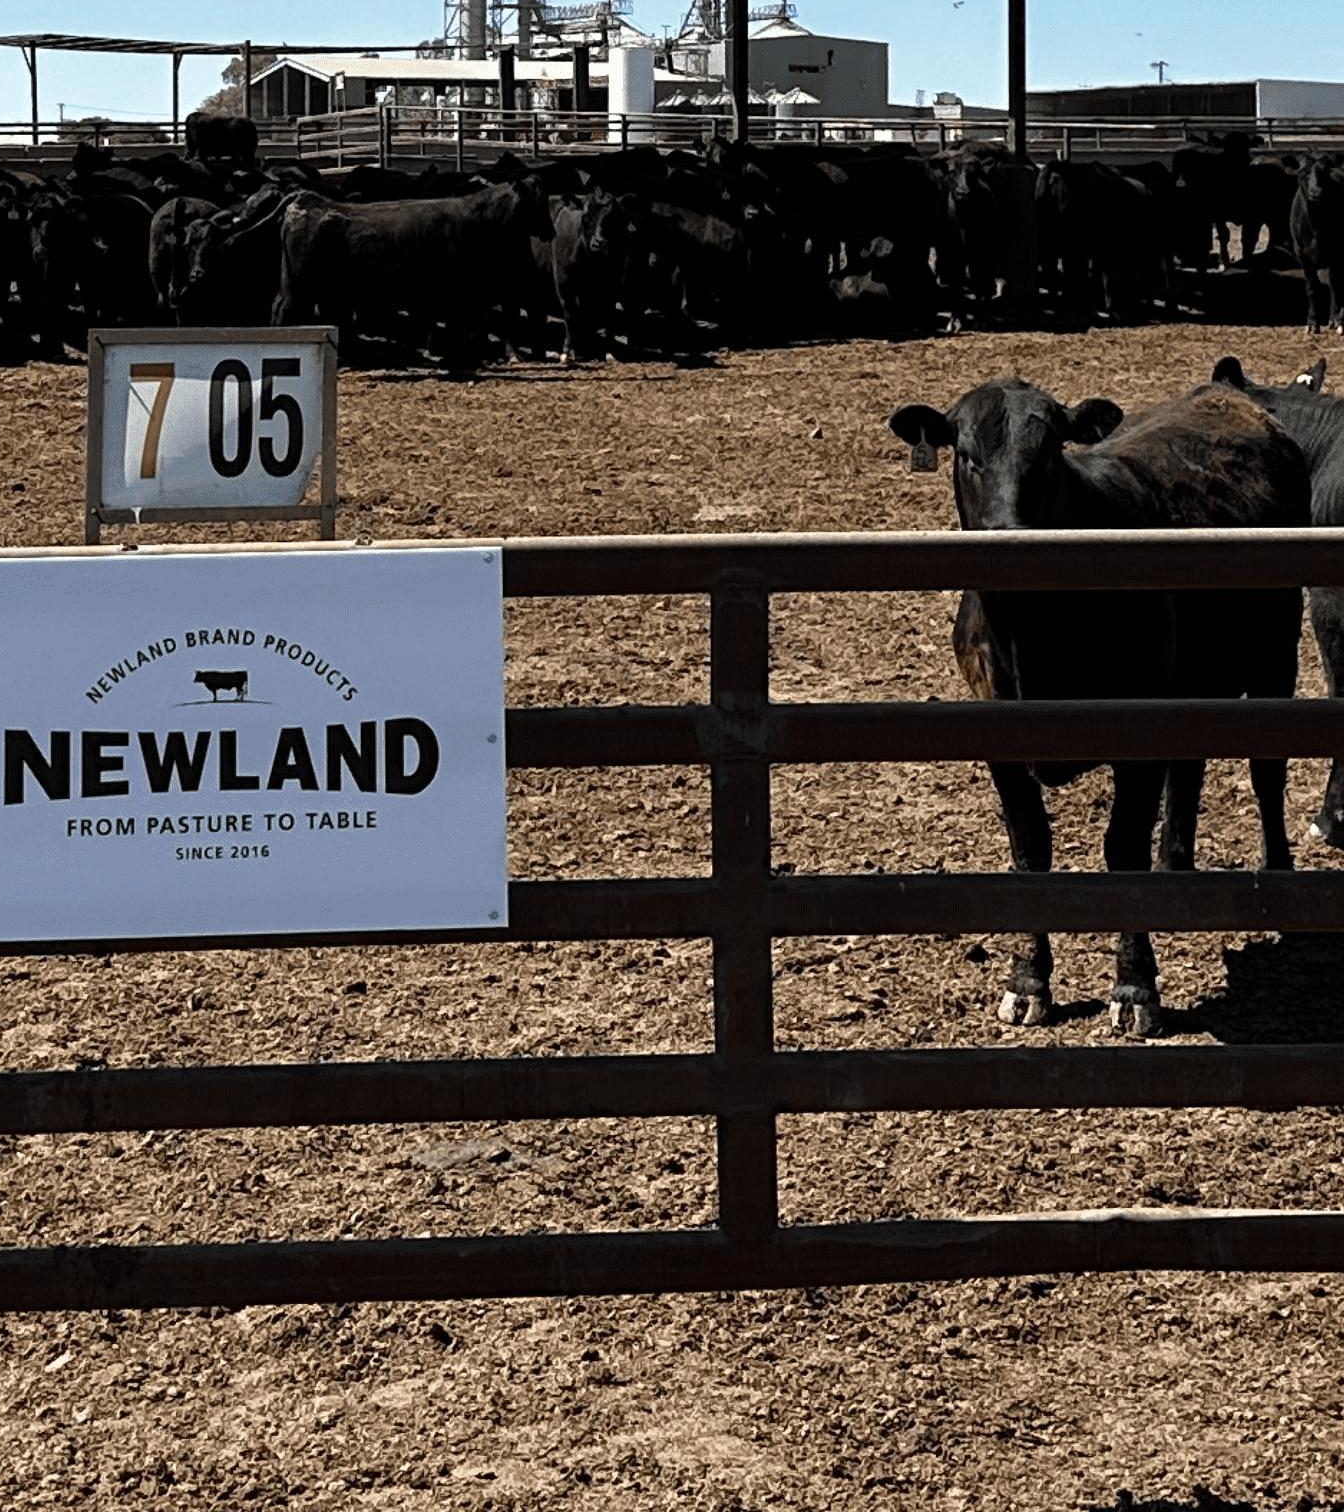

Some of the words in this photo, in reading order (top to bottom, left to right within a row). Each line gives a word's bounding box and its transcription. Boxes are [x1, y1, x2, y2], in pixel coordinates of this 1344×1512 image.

[85, 637, 177, 705] NEWLAND
[185, 628, 256, 648] BRAND
[262, 634, 359, 702] PRODUCTS
[3, 717, 440, 806] NEWLAND
[67, 817, 135, 837] FROM
[146, 814, 253, 835] PASTURE
[263, 813, 295, 832] TO
[304, 810, 377, 830] TABLE
[175, 846, 224, 861] SINCE
[230, 844, 270, 859] 2016
